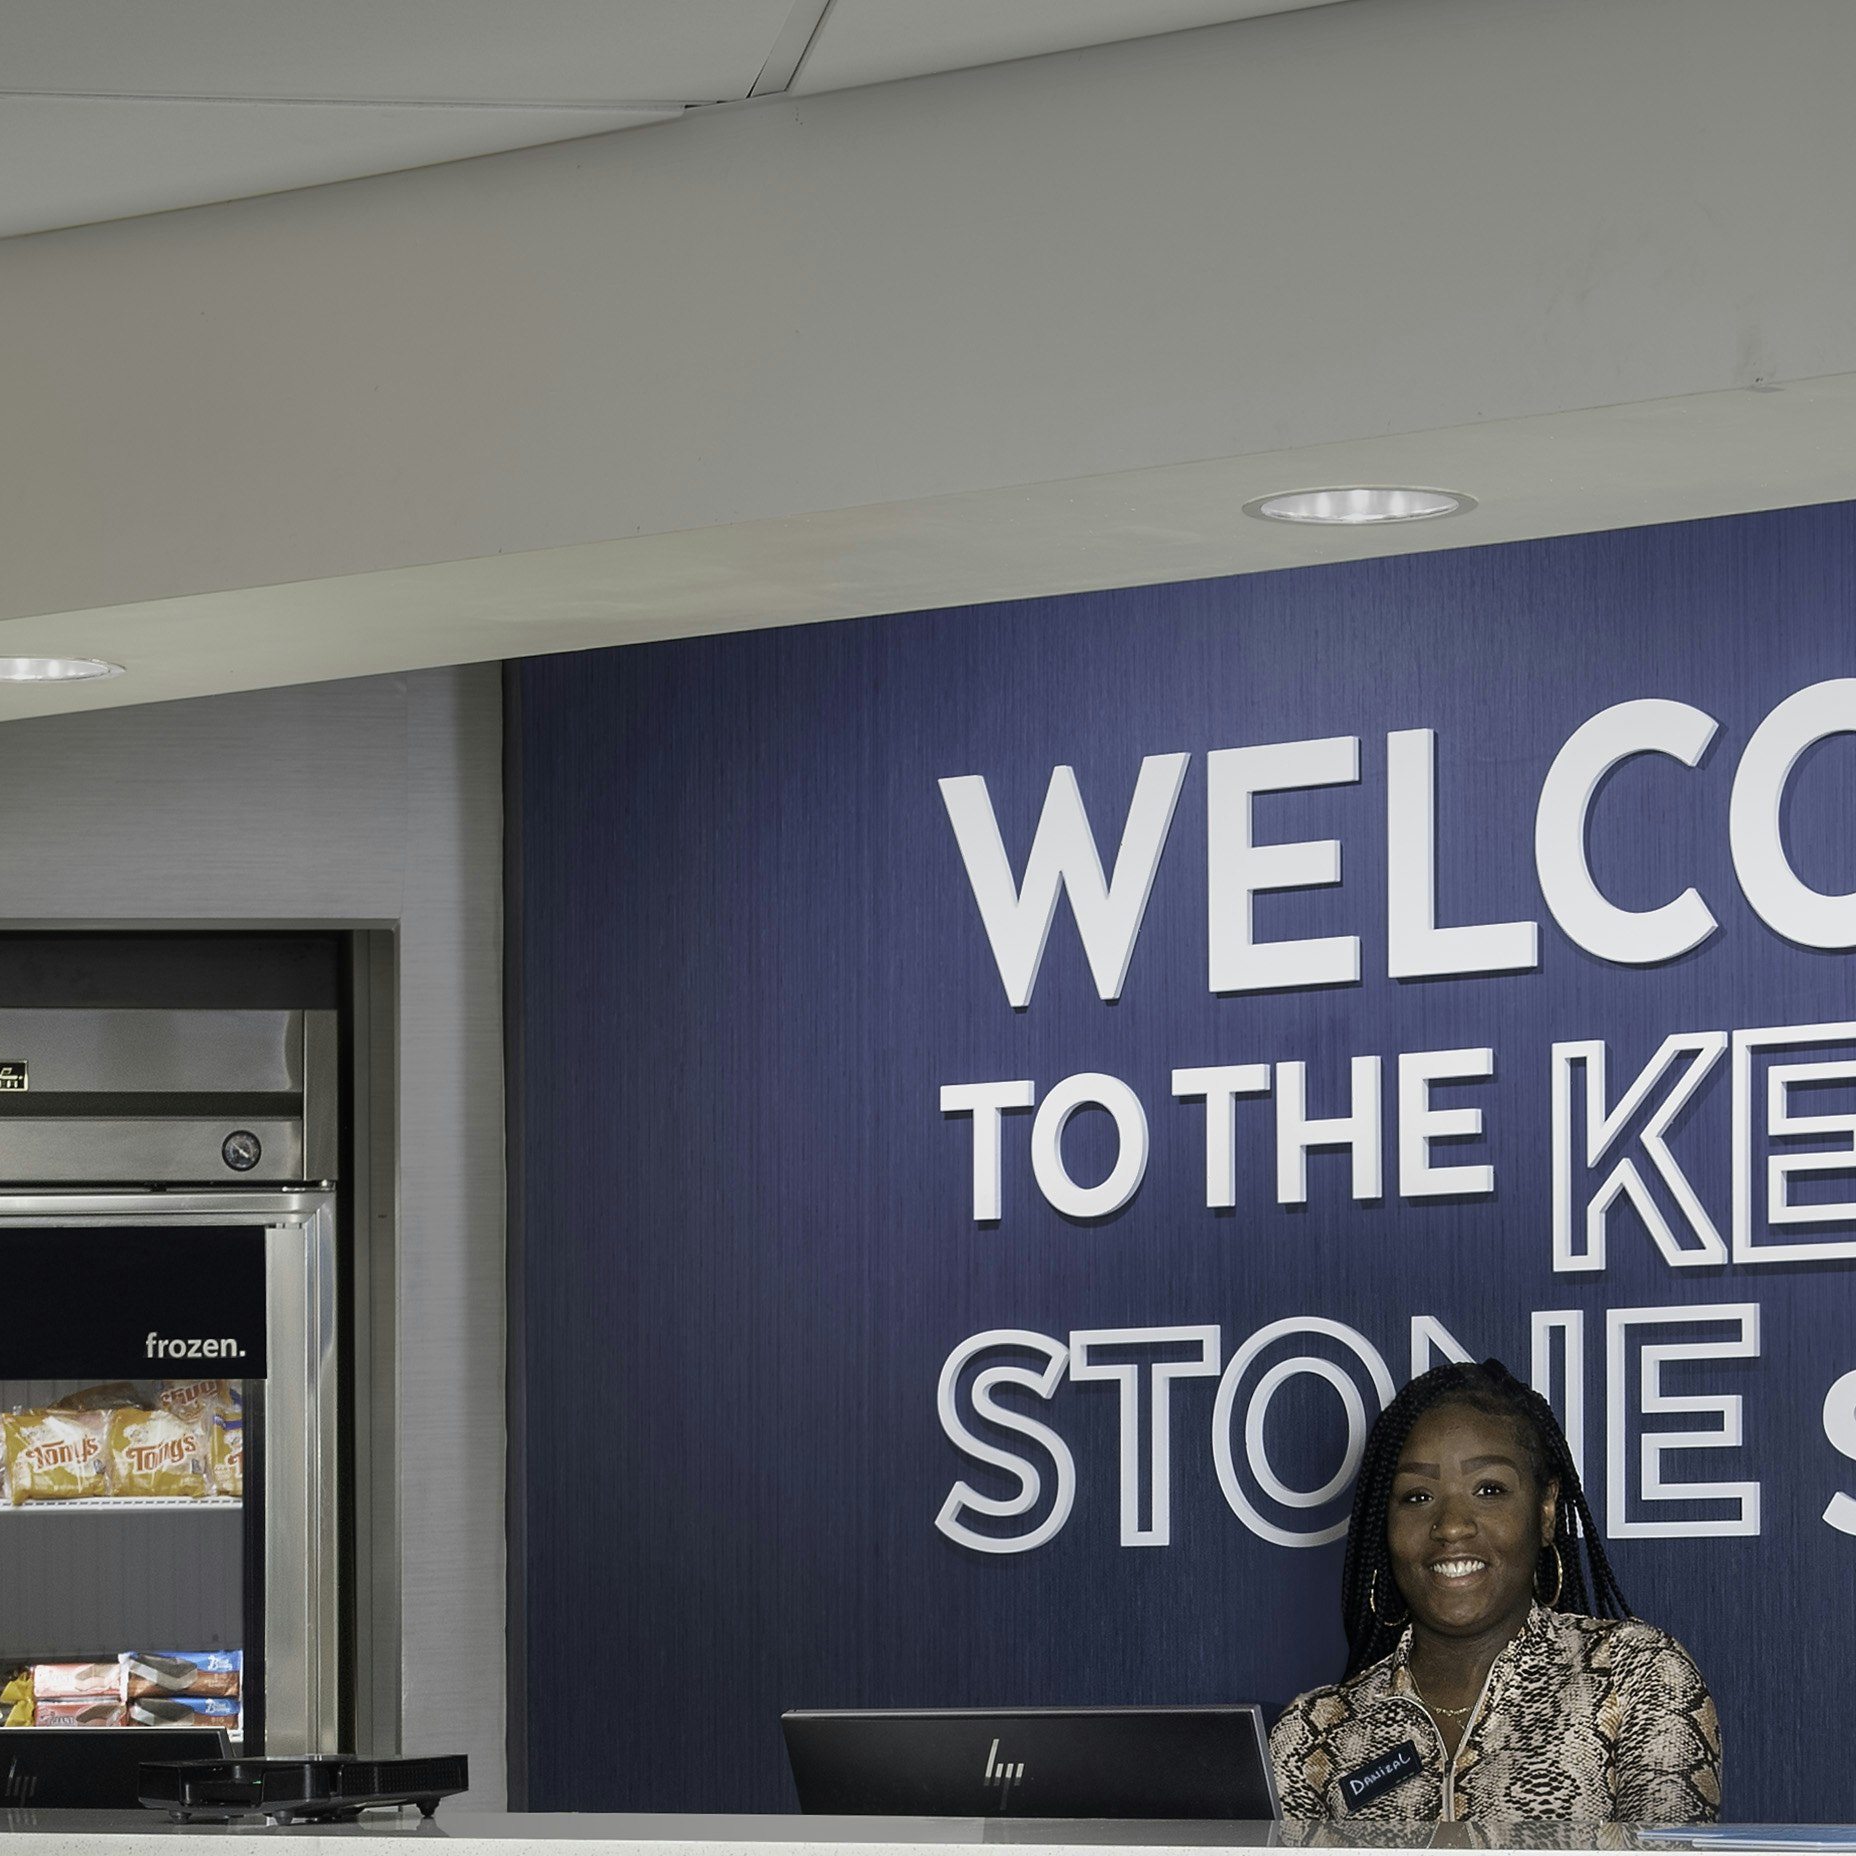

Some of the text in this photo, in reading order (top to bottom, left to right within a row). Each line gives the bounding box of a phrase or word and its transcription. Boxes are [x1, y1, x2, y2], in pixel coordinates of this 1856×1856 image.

[940, 1073, 1149, 1221] TO
[1172, 1048, 1494, 1208] THE
[145, 1332, 246, 1358] frozen.
